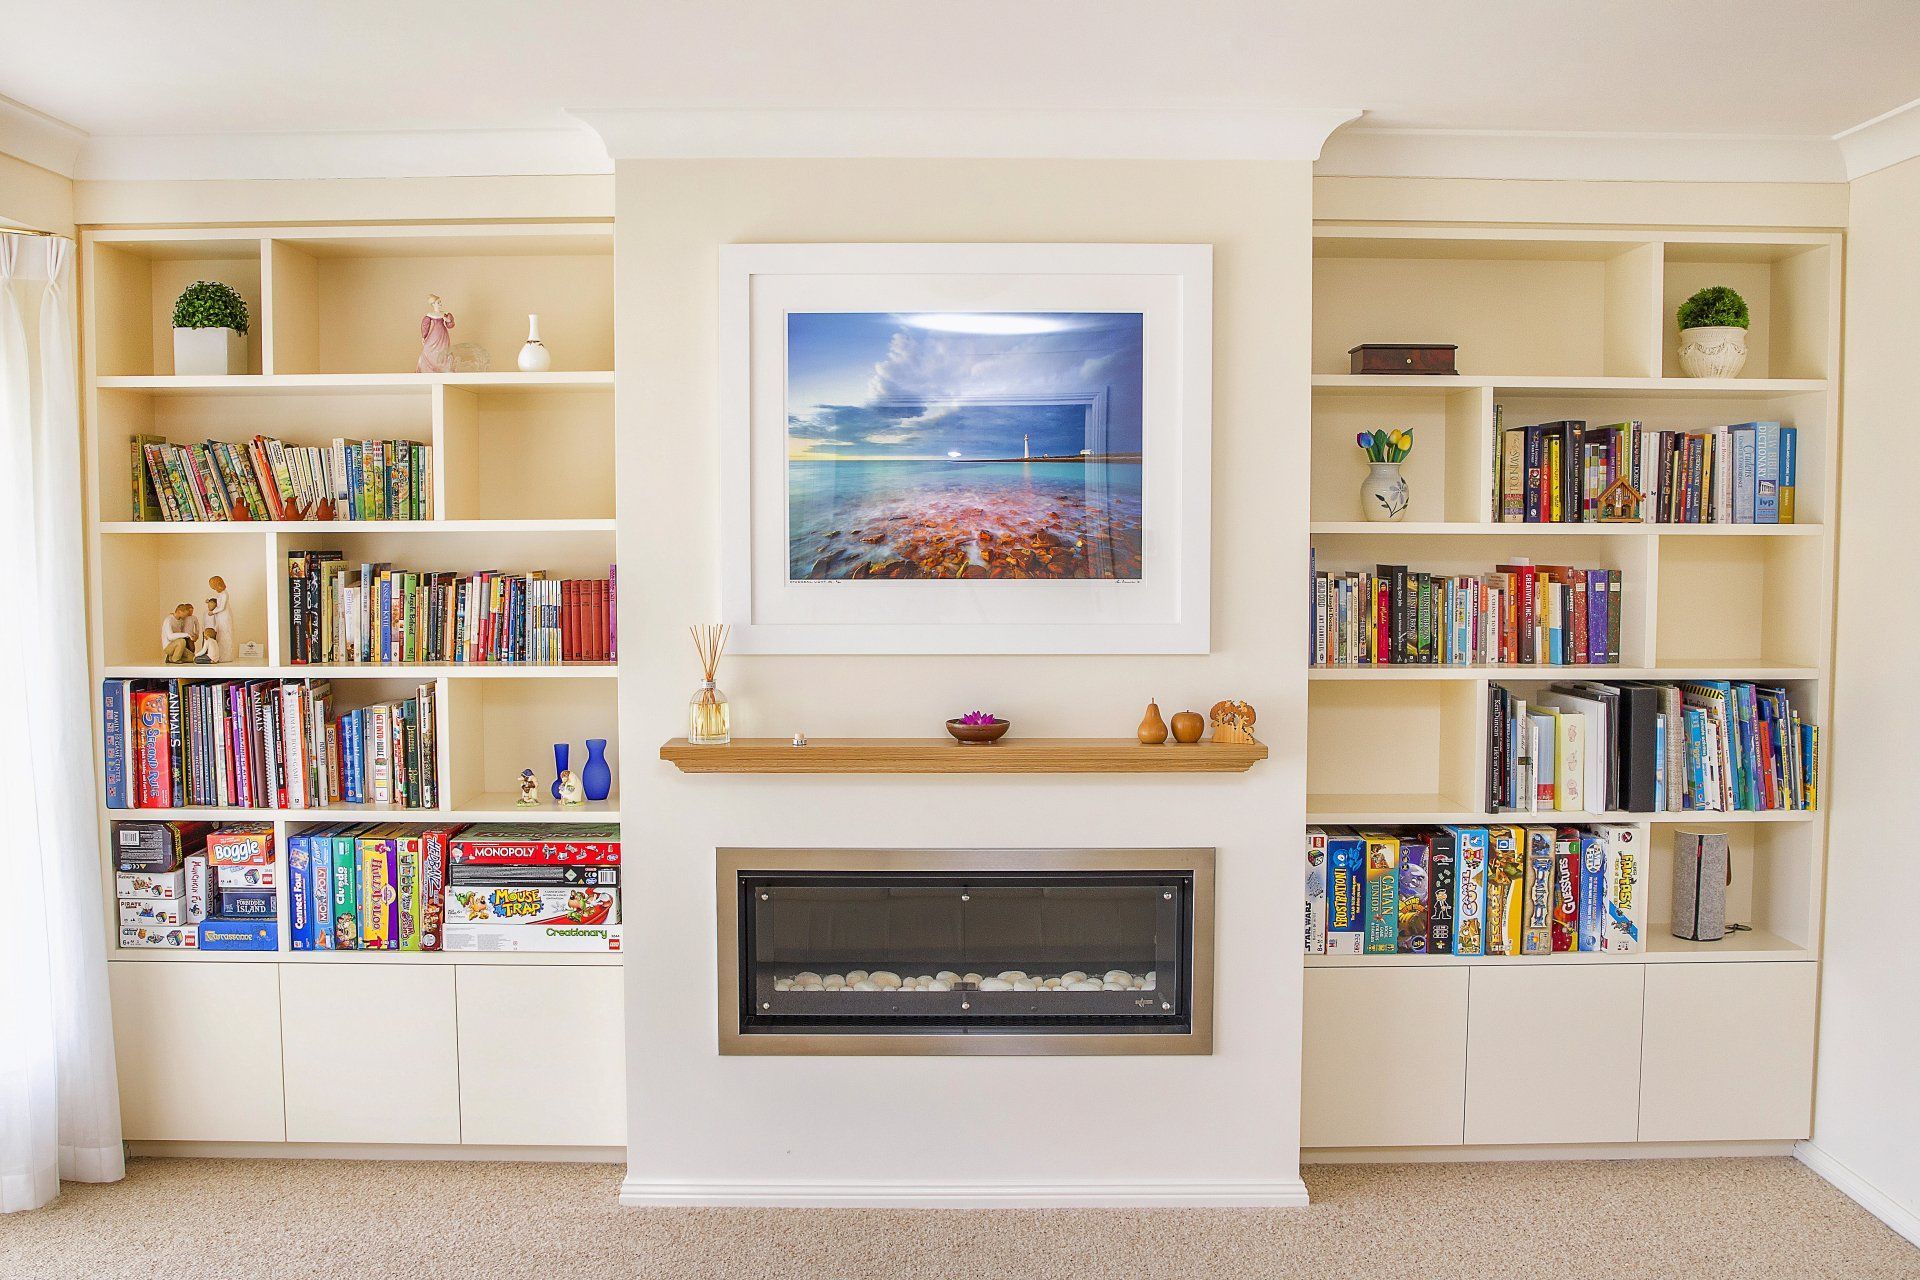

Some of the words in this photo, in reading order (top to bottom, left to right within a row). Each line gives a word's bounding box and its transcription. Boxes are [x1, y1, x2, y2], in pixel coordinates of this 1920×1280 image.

[1768, 426, 1776, 447] NEW
[1758, 426, 1766, 477] DICTIONARY
[1768, 453, 1776, 478] BIBLE
[142, 712, 163, 727] 5
[169, 692, 180, 747] ANIMALS
[253, 691, 263, 731] ANIMALS
[376, 714, 385, 725] GET
[376, 726, 385, 738] INTO
[377, 742, 385, 757] BIBLE
[214, 838, 259, 862] Boggle
[475, 848, 534, 856] MONOPOLY
[293, 872, 302, 892] Four
[336, 867, 345, 905] Cluedo
[1619, 855, 1633, 910] FANTASY
[1334, 868, 1348, 928] FRUSTRATION!
[1370, 880, 1379, 912] JUNIOR
[1382, 875, 1394, 915] CATAN
[236, 905, 266, 914] ISLAND
[294, 893, 304, 929] Connect
[503, 903, 541, 918] TRAP
[1492, 885, 1500, 942] ESCAPE
[205, 930, 252, 942] Carcassonne
[546, 928, 607, 939] Creationary
